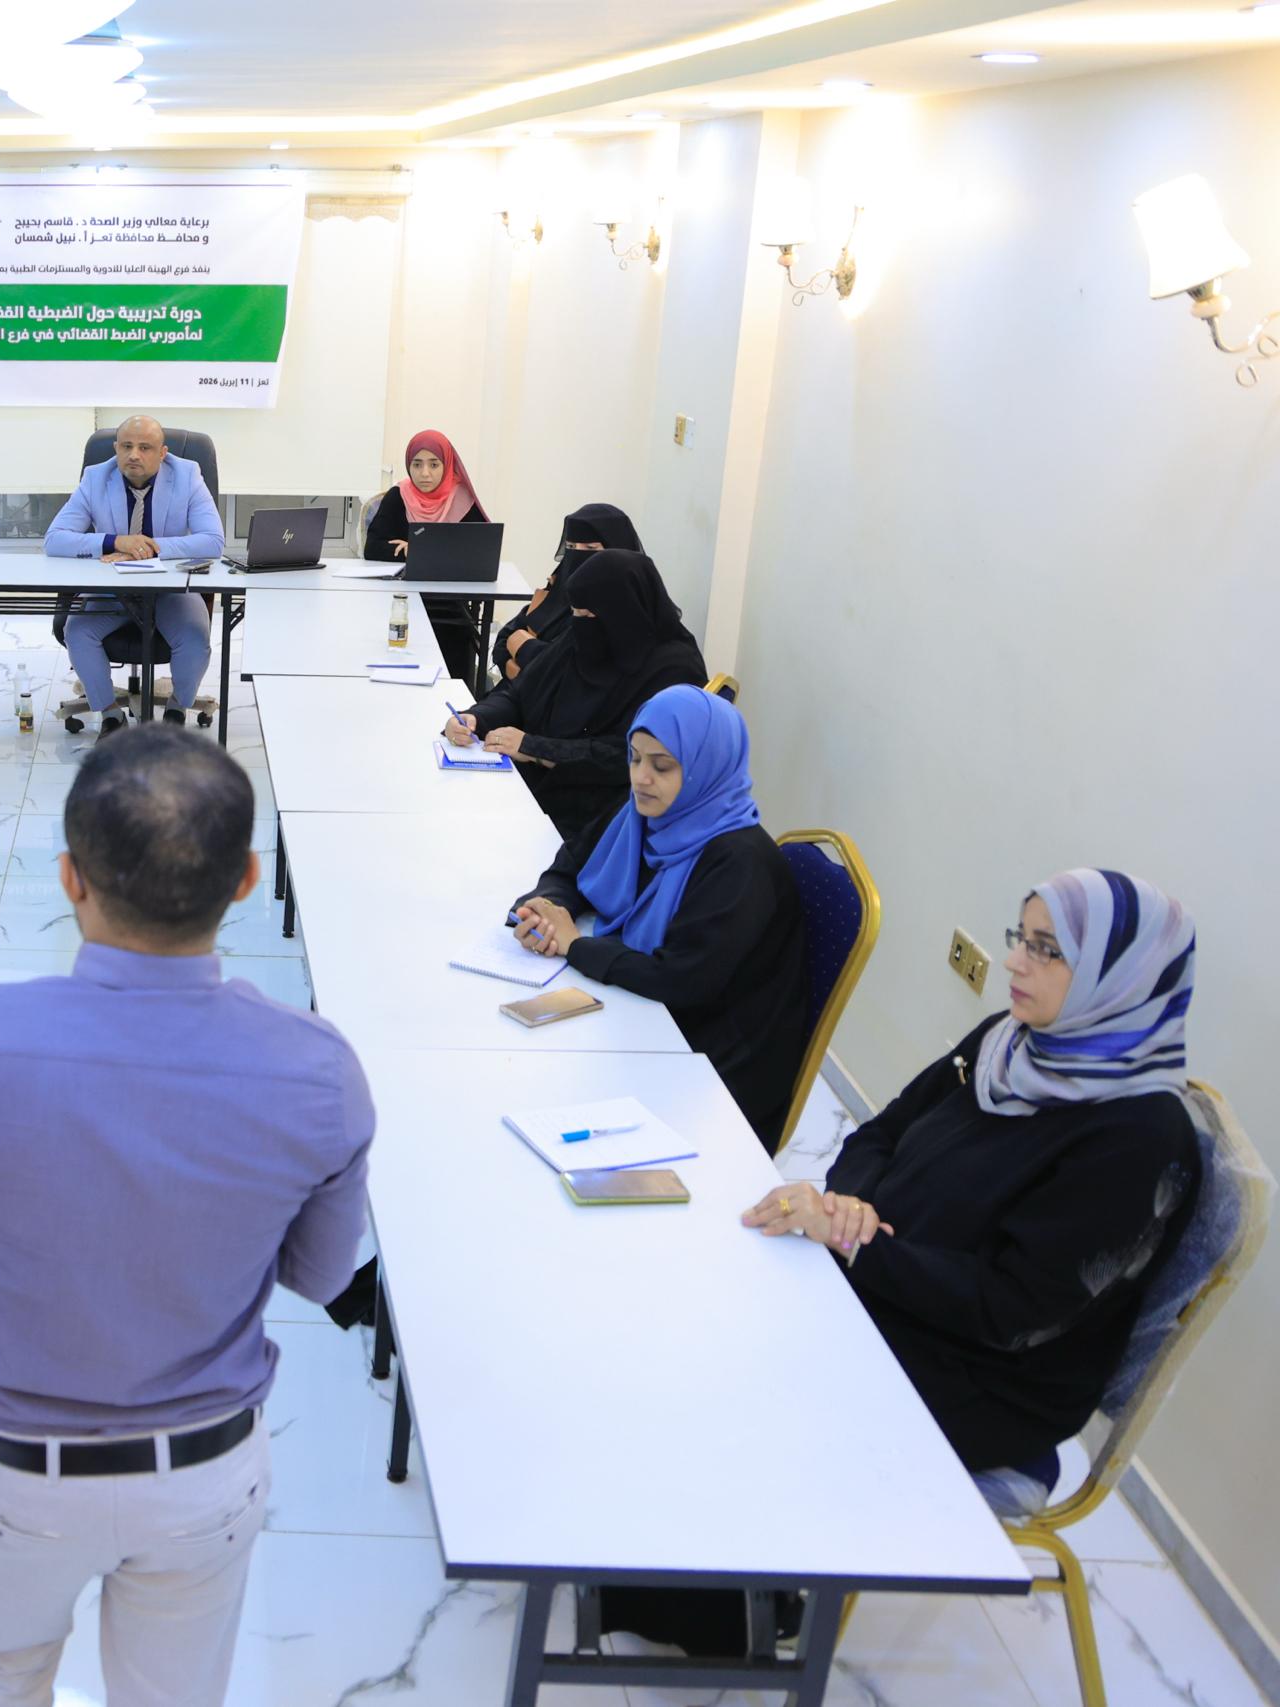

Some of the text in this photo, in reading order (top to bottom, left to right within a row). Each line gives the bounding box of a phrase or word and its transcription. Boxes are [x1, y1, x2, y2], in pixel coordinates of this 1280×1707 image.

[14, 217, 42, 230] بحيبح
[43, 216, 74, 230] قاسم
[89, 216, 120, 227] الصحة
[121, 216, 143, 229] وزير
[145, 216, 178, 229] معالي
[179, 217, 210, 229] برعاية
[14, 231, 54, 245] شمسان
[55, 232, 77, 245] نبيل
[114, 232, 155, 243] محافظة
[9, 264, 37, 275] الطبية
[37, 264, 92, 275] والمستلزمات
[124, 264, 146, 275] العليا
[173, 265, 191, 276] فرع
[27, 305, 84, 322] الضبطية
[86, 305, 115, 323] حول
[117, 305, 168, 323] تدريبية
[169, 305, 202, 323] دورة
[7, 328, 30, 344] فرع
[32, 328, 55, 343] في
[57, 327, 109, 343] القضائي
[110, 328, 147, 343] الضبط
[148, 325, 203, 344] لمأموري
[198, 377, 219, 386] 2026
[240, 377, 250, 386] 11
[256, 377, 270, 388] تعز
